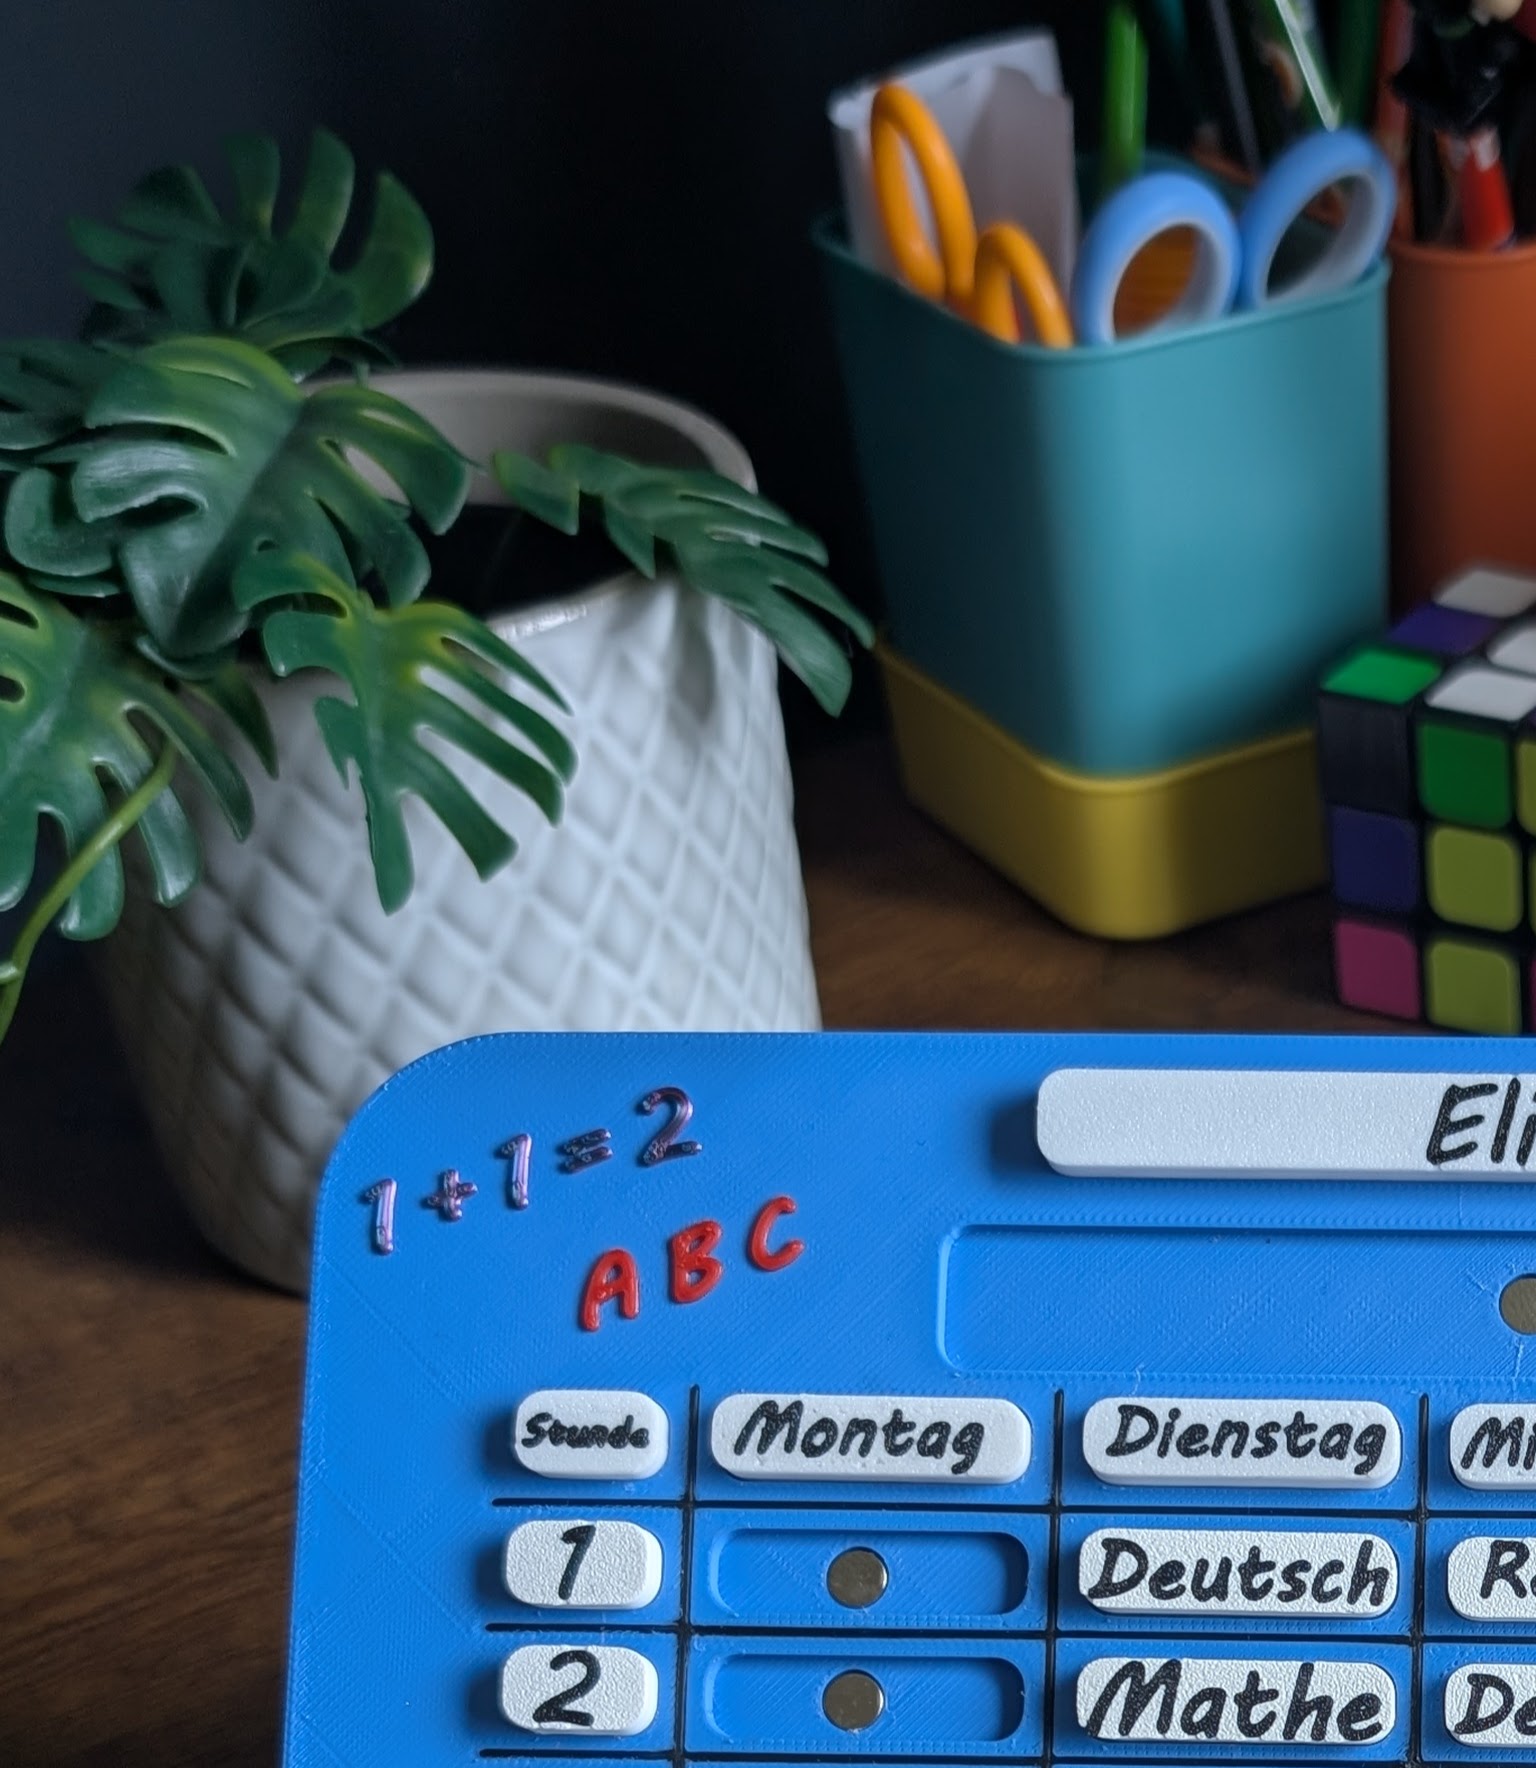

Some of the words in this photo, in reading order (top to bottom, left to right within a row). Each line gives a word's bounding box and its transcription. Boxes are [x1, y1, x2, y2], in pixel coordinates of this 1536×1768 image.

[520, 1410, 650, 1450] Stunde
[733, 1401, 986, 1475] Montag
[1105, 1405, 1389, 1475] Dienstag
[558, 1526, 598, 1600] 1
[1086, 1538, 1391, 1605] Deutsch
[532, 1651, 601, 1727] 2
[1083, 1661, 1384, 1742] Mathe
